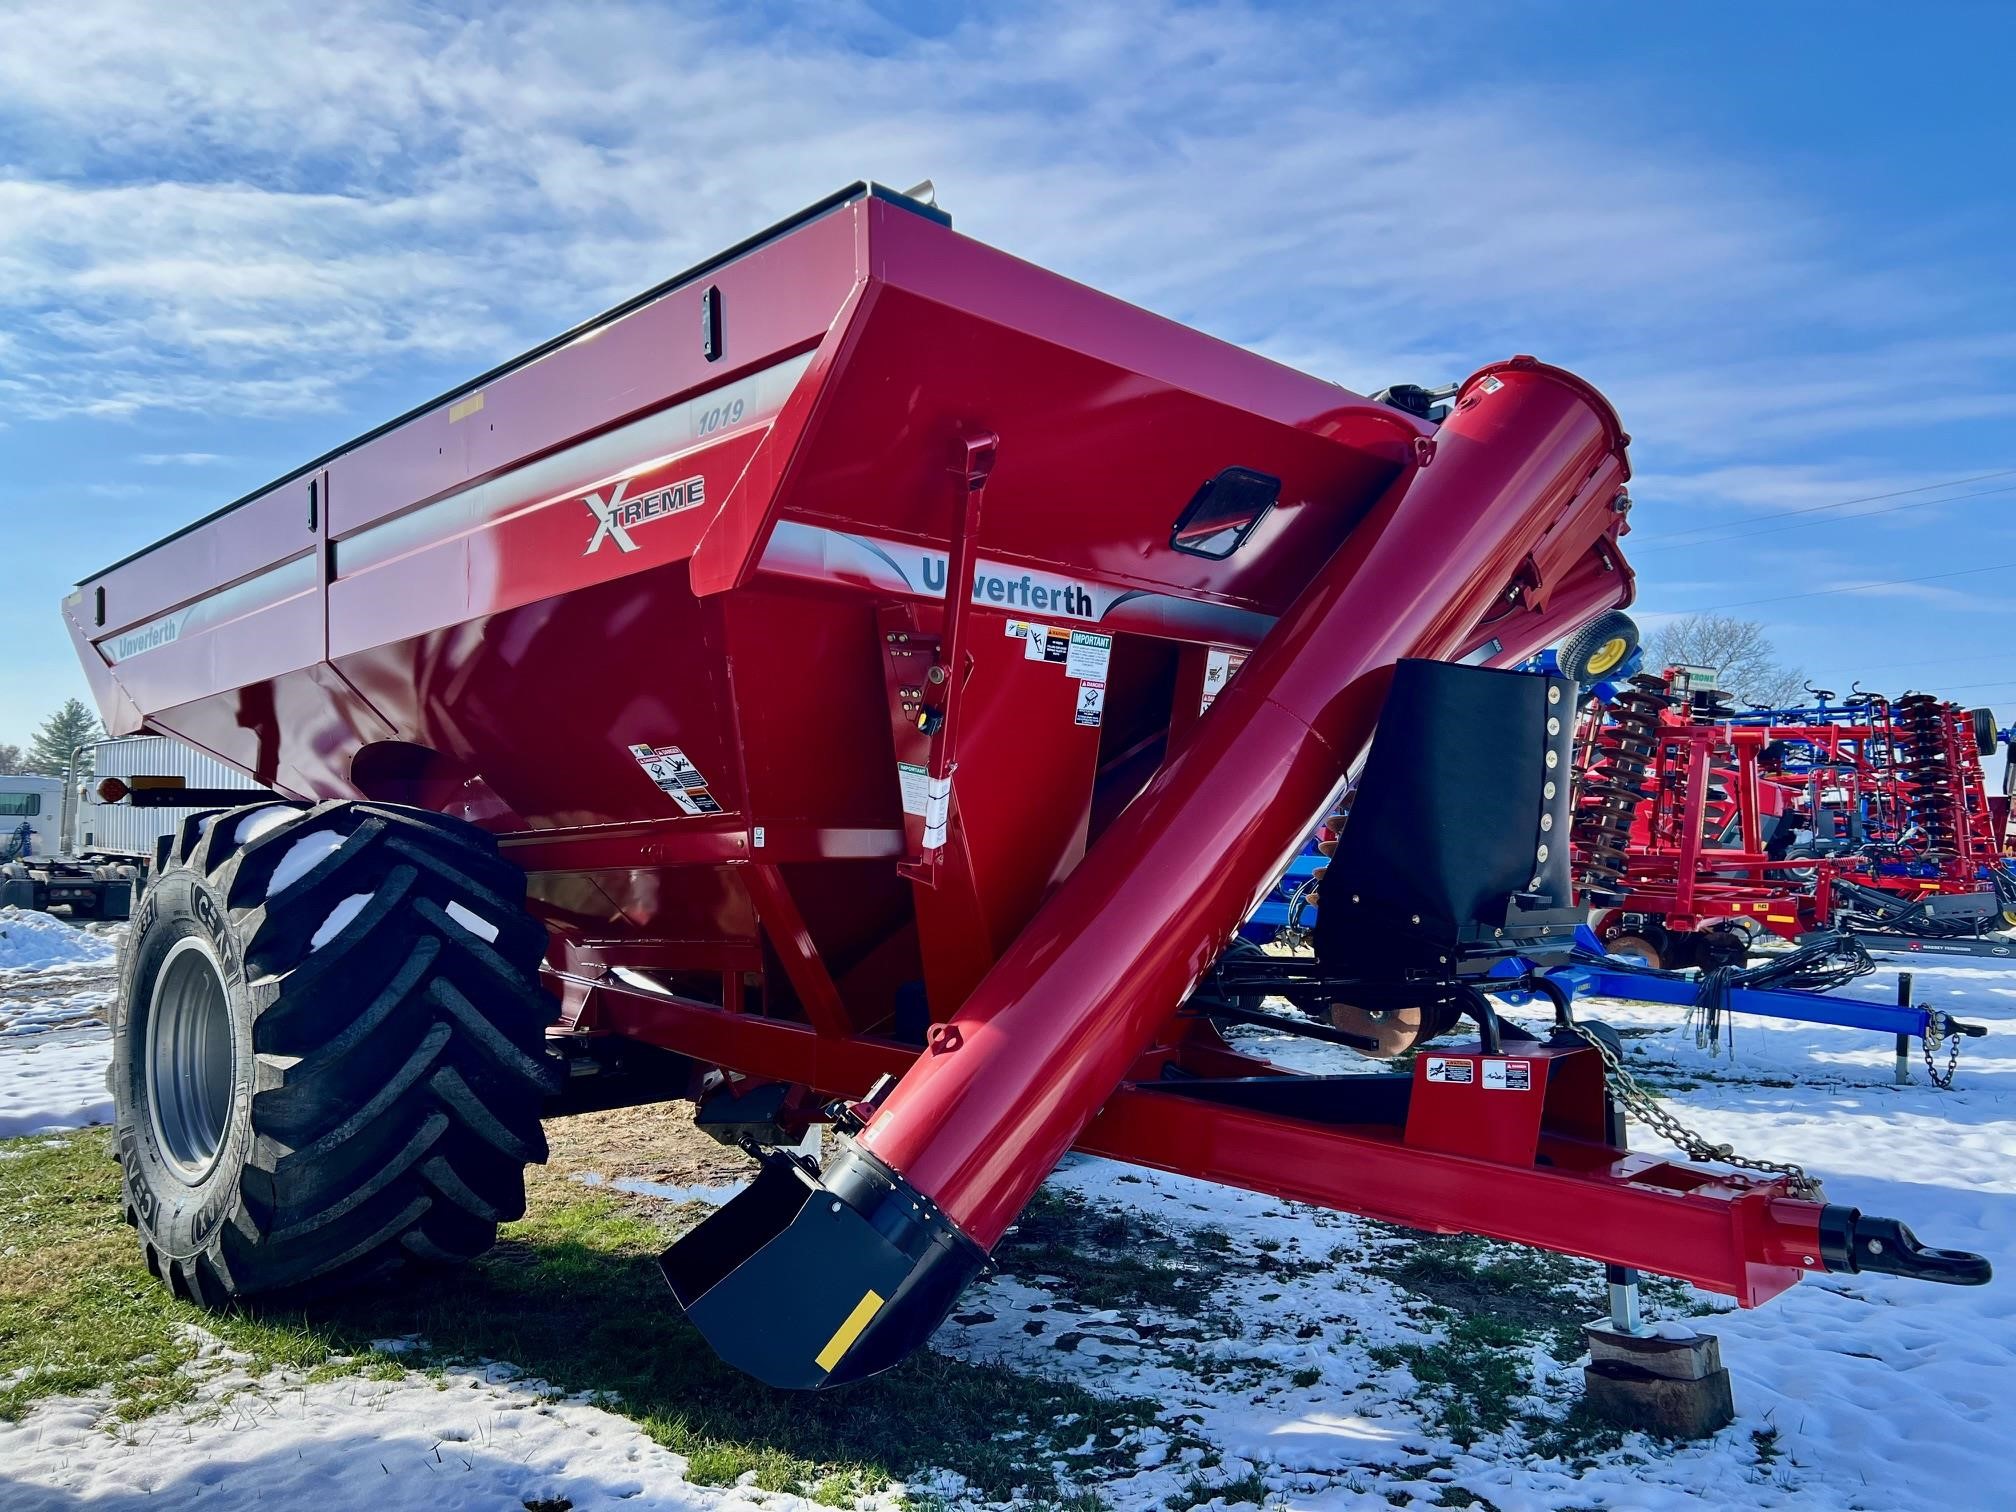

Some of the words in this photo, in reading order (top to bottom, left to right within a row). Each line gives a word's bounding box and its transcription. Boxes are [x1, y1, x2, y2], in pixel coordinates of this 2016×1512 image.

[699, 398, 744, 437] 1019
[578, 476, 705, 556] XTREME
[922, 555, 1093, 619] Uverferth
[119, 618, 176, 659] Unverferth
[1072, 632, 1110, 648] IMPORTANT
[900, 764, 926, 775] IMPORTANT
[199, 894, 235, 971] CEAT
[123, 1142, 151, 1220] CEAT
